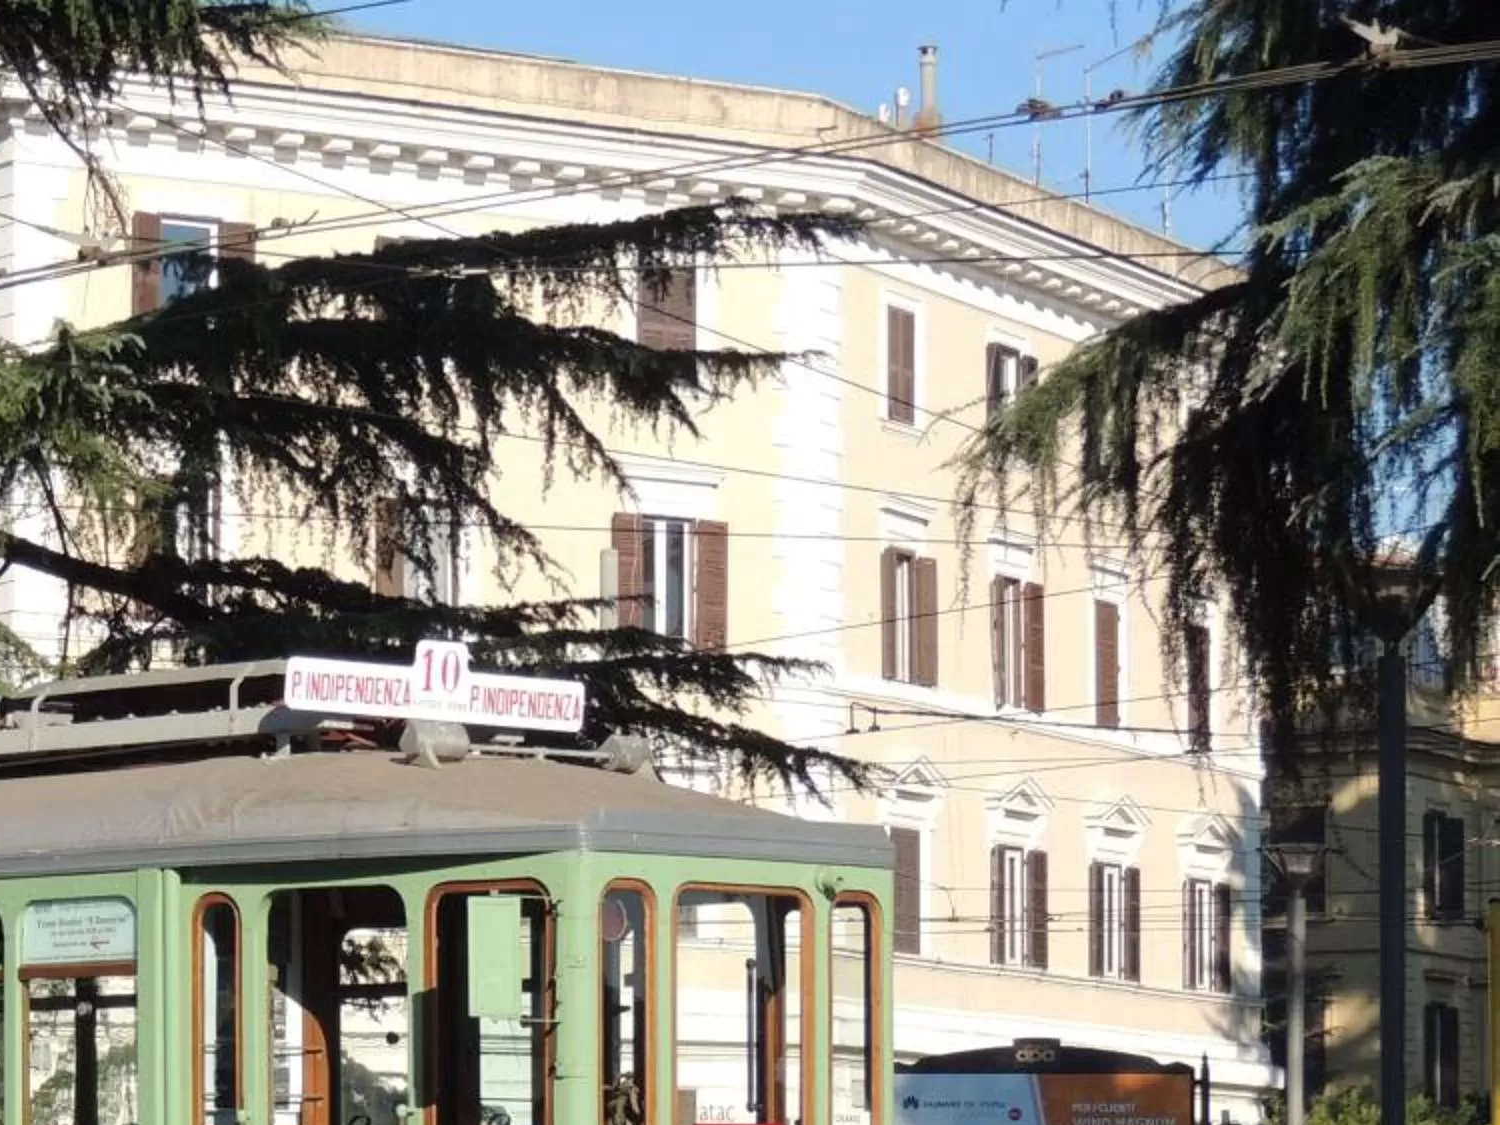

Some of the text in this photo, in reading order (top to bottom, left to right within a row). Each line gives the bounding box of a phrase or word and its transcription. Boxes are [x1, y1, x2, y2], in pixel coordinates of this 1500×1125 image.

[421, 648, 461, 692] 10
[305, 672, 411, 706] INDIPENDENZA
[483, 687, 582, 721] INDIPENDENZA
